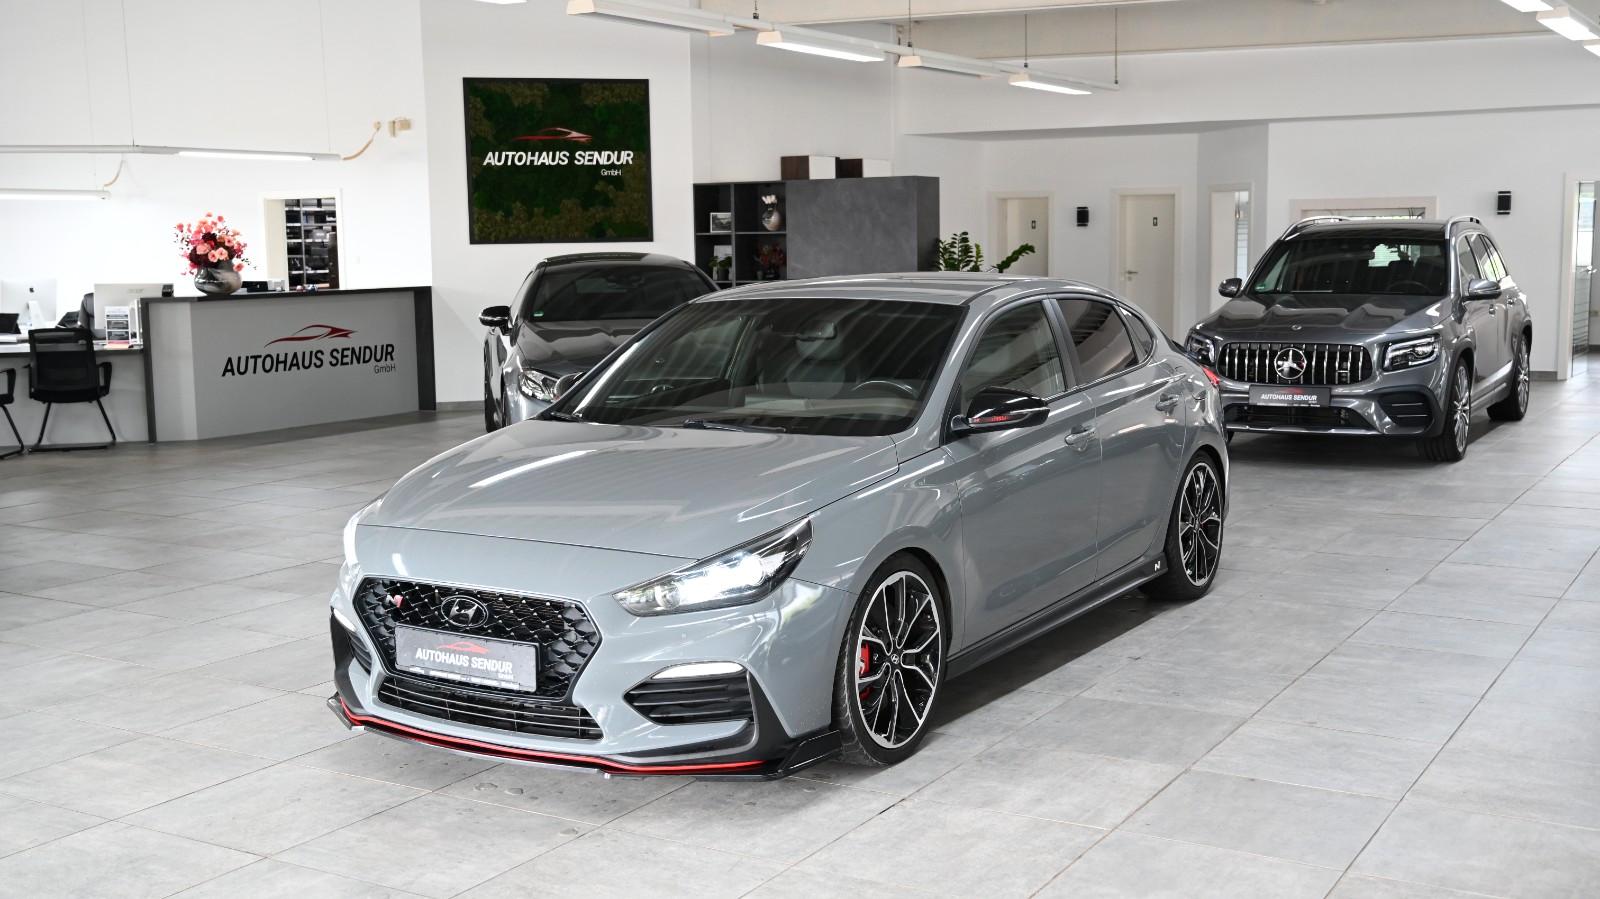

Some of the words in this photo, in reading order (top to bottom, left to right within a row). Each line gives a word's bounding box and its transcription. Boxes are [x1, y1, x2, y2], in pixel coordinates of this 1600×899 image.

[483, 150, 570, 166] AUTOHAUS
[574, 150, 634, 166] SENDUR
[600, 168, 622, 177] GmbH
[221, 349, 325, 377] AUTOHAUS
[328, 343, 396, 368] SENDUR
[374, 363, 397, 375] GmbH
[1260, 393, 1292, 401] AUTOHAUS
[415, 647, 470, 668] AUTOHAUS
[470, 656, 513, 674] SENDUR
